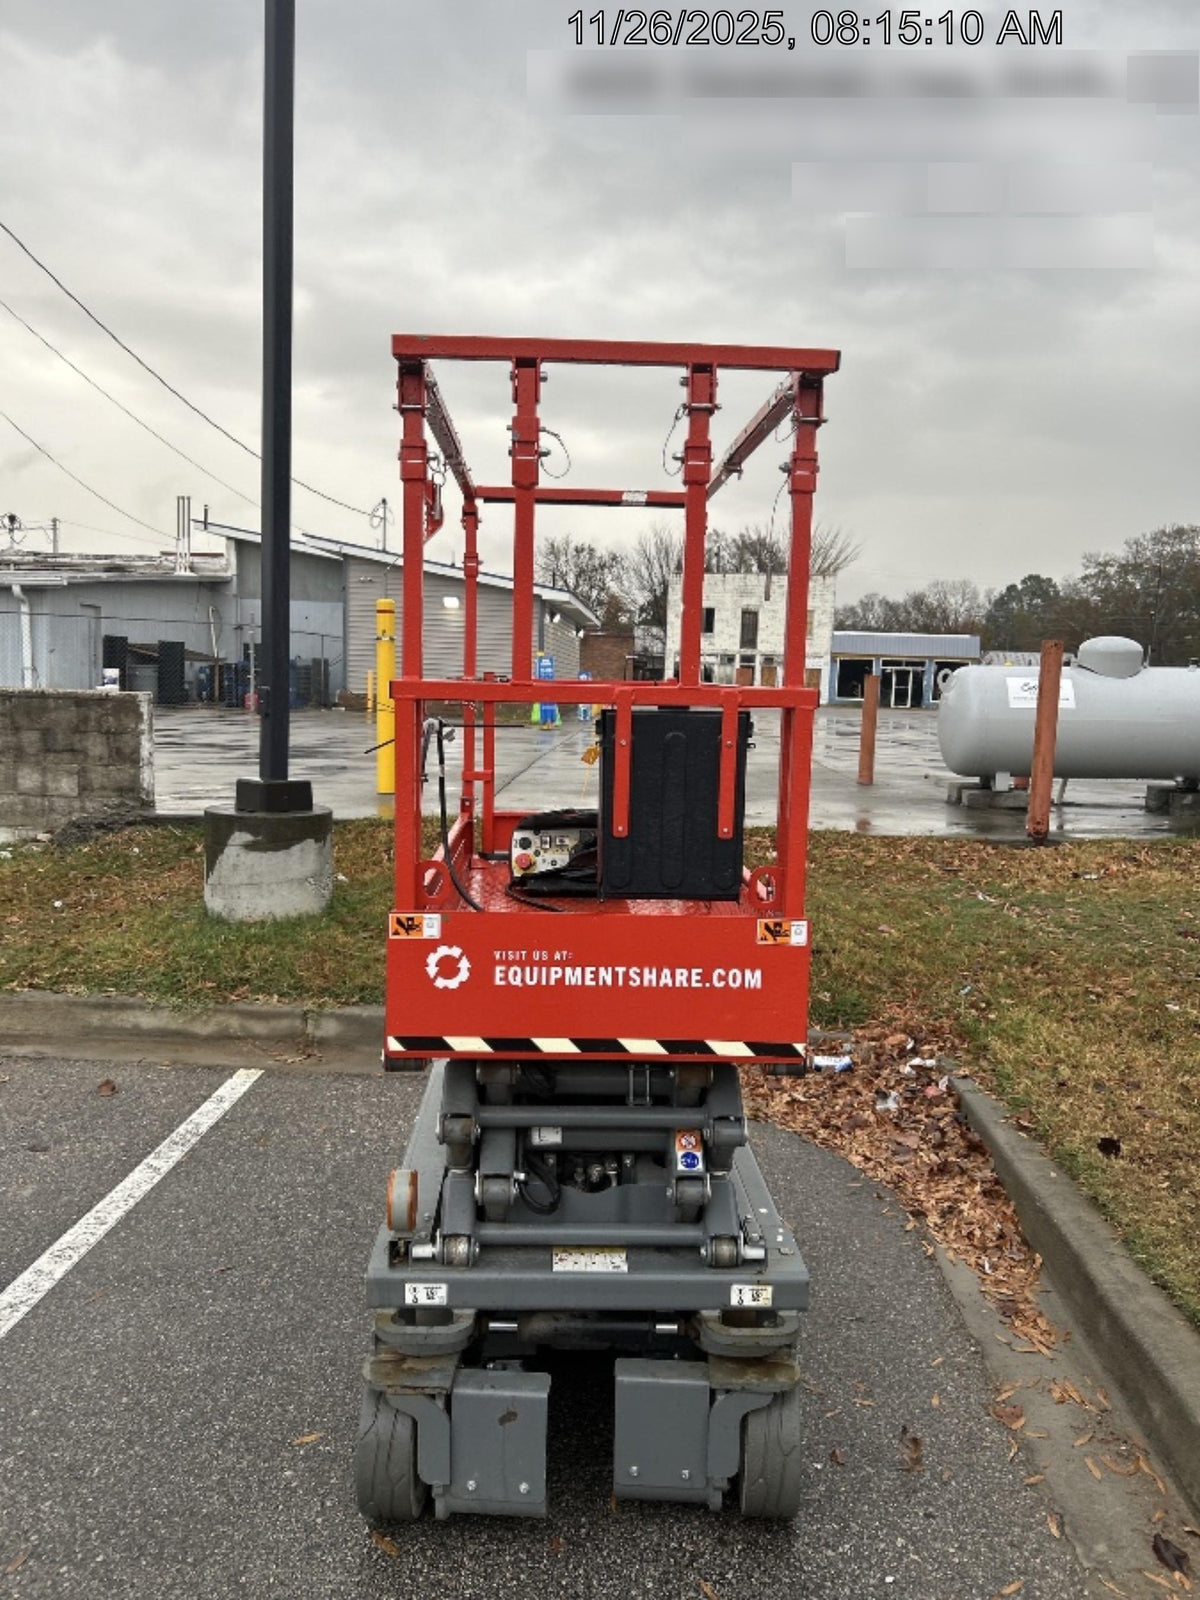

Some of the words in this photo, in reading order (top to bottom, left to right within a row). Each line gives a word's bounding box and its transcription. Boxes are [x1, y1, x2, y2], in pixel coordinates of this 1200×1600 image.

[494, 950, 527, 961] VISIT
[533, 950, 548, 961] US
[494, 965, 763, 990] EQUIPMENTSHARE.COM
